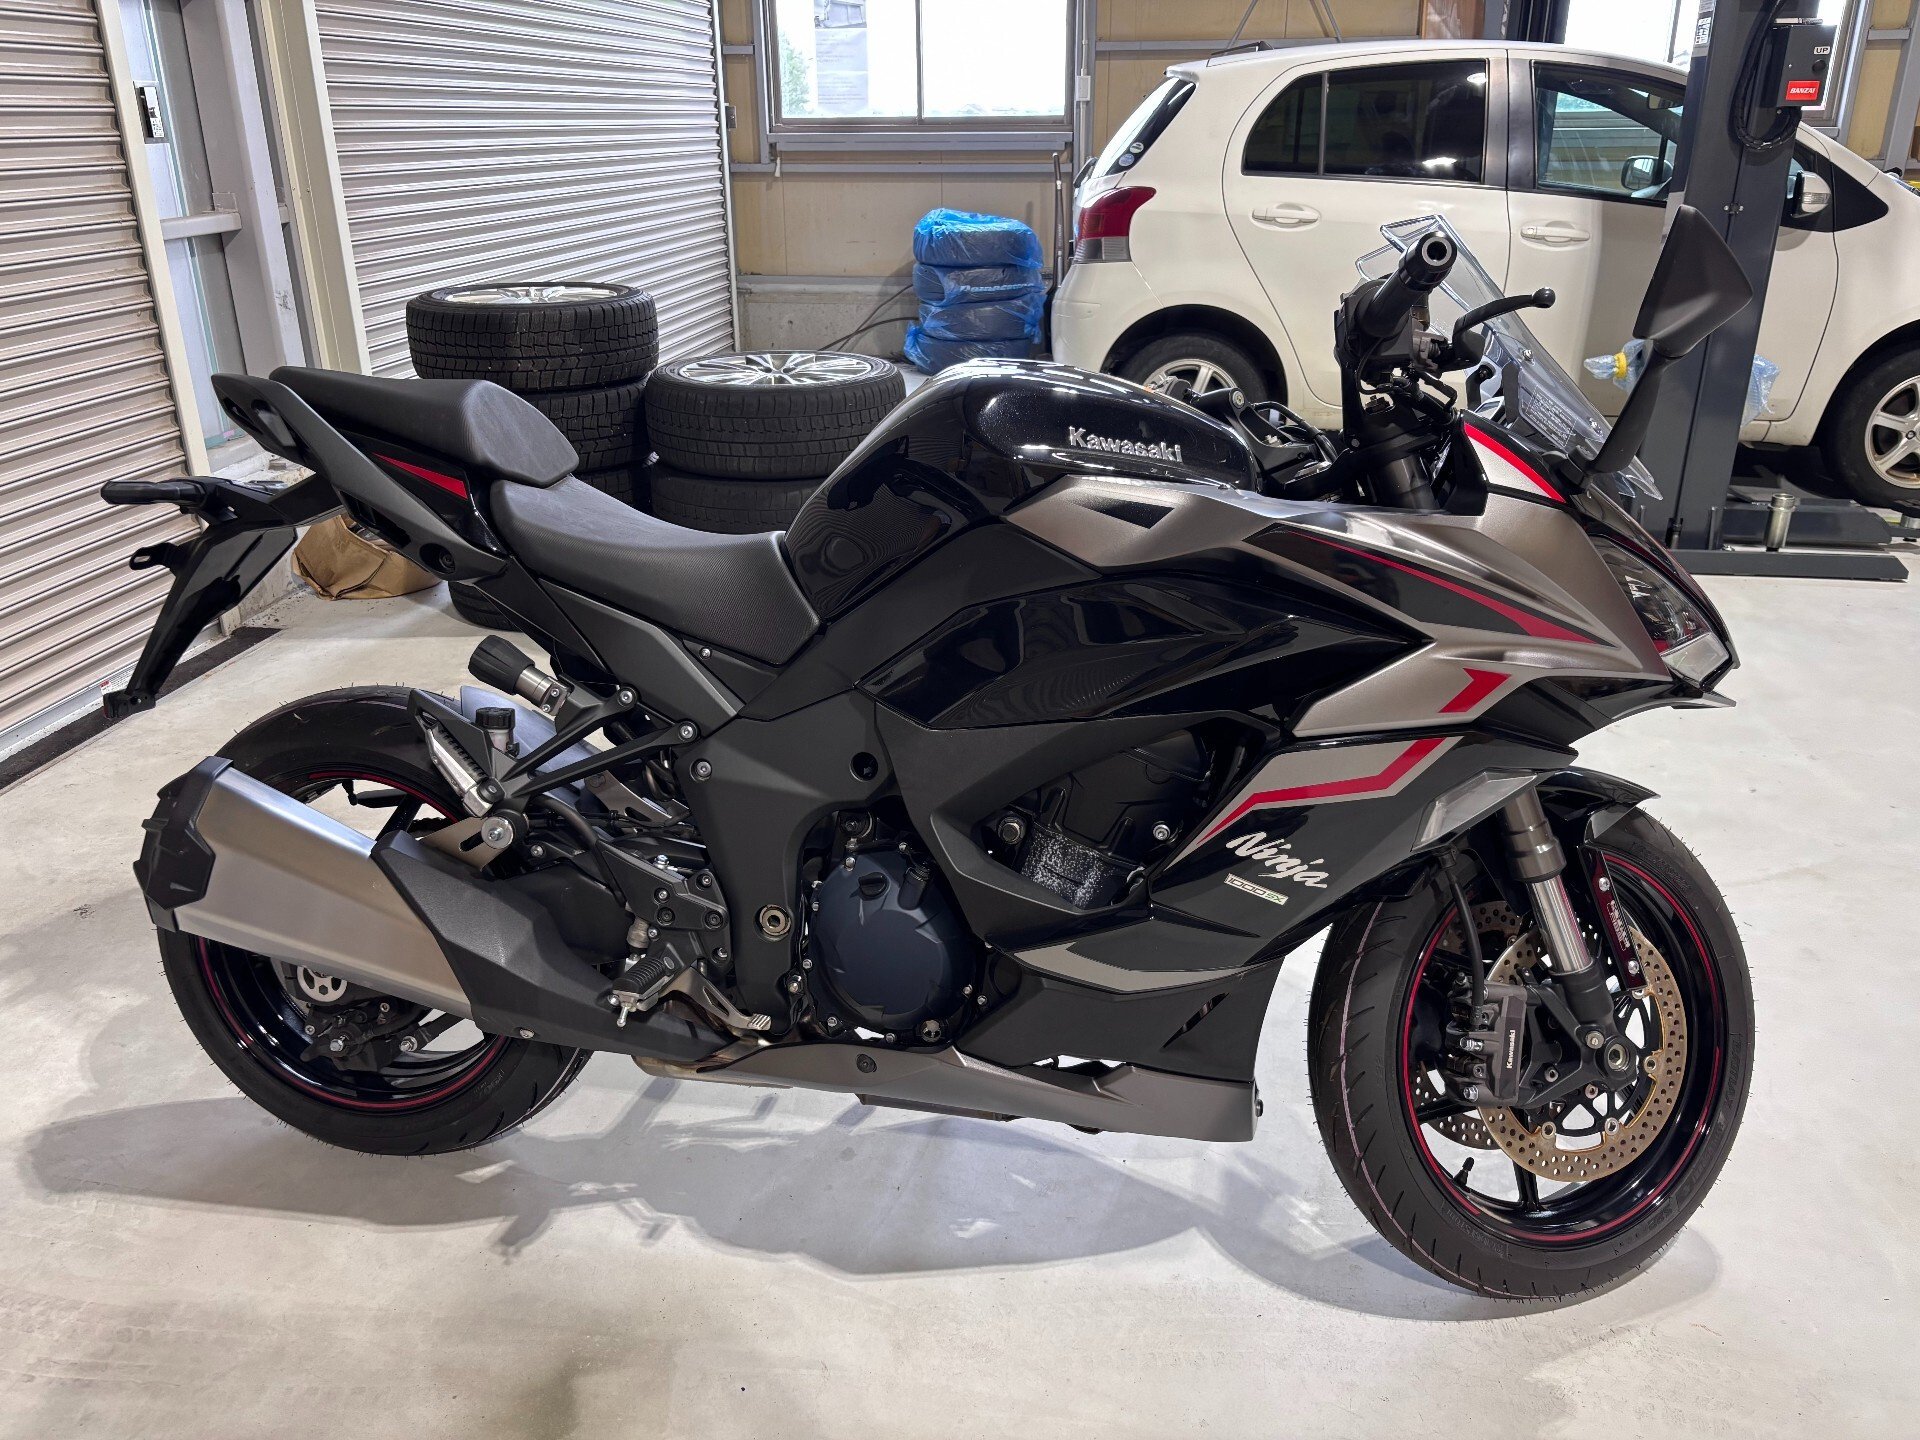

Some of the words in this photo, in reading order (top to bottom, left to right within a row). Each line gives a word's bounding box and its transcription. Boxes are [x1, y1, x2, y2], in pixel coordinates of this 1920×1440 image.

[1069, 425, 1183, 462] Kawasaki
[1225, 831, 1329, 888] Ninja
[1226, 876, 1286, 903] 1000SX
[1506, 1029, 1516, 1069] Kawasaki
